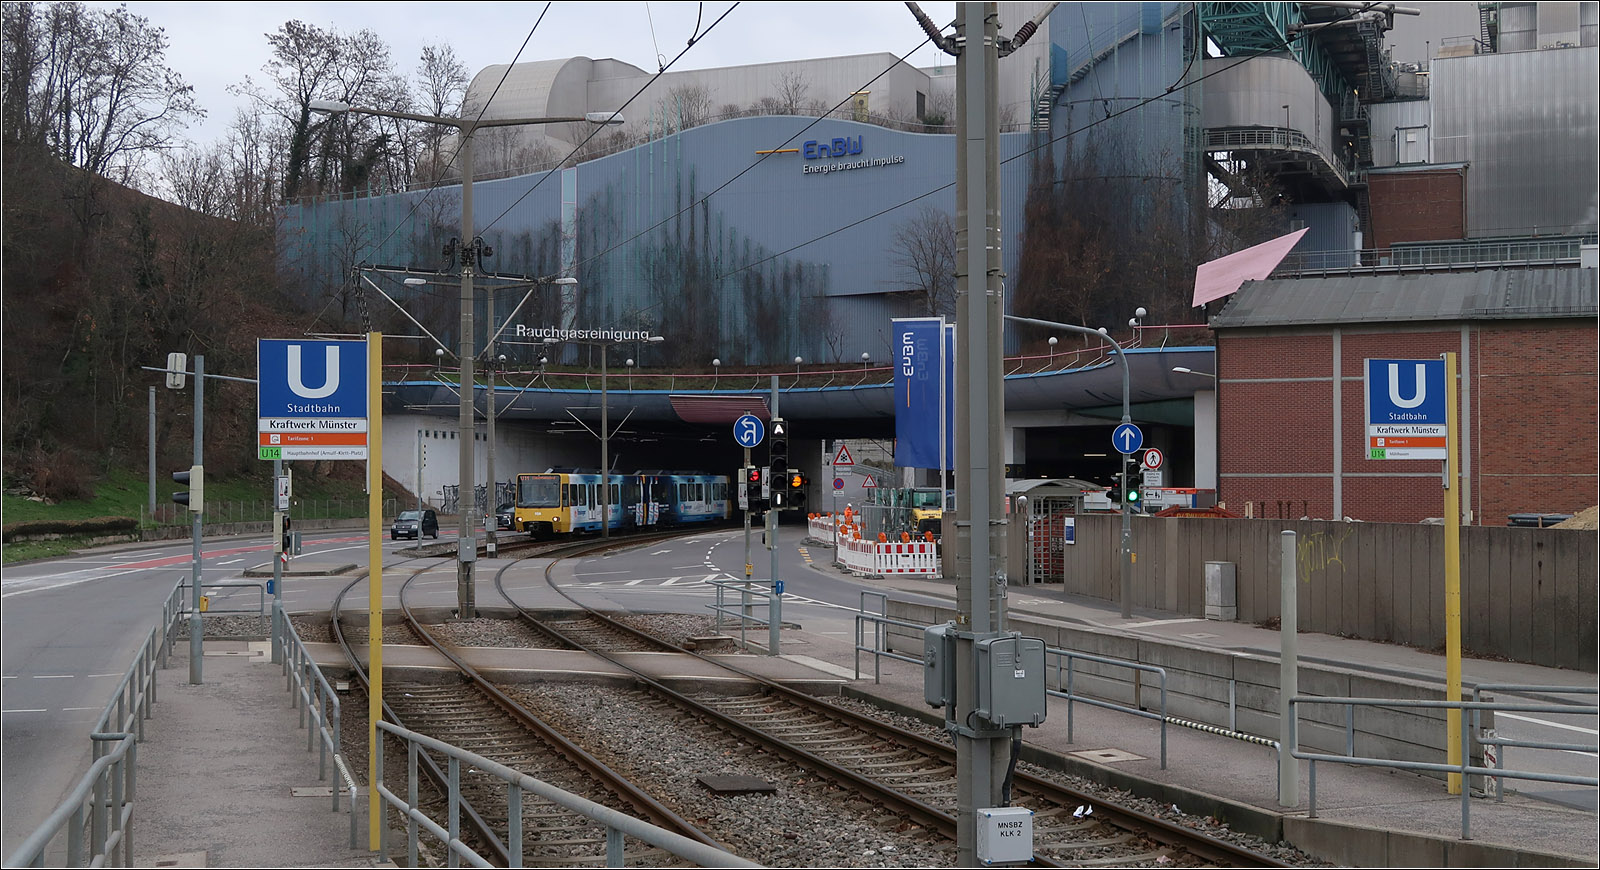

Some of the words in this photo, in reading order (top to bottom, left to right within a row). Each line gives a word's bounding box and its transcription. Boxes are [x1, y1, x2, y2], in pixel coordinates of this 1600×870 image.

[803, 135, 863, 159] EnBW
[803, 164, 836, 174] Energie
[838, 159, 870, 171] braucht
[871, 154, 904, 167] Impulse
[516, 324, 649, 342] Rauchgasreinigung
[288, 344, 340, 398] U
[1388, 364, 1426, 408] U
[287, 404, 340, 413] Stadtbahn
[270, 420, 316, 429] Kraftwerk
[319, 420, 358, 429] Münster
[262, 449, 280, 457] U14
